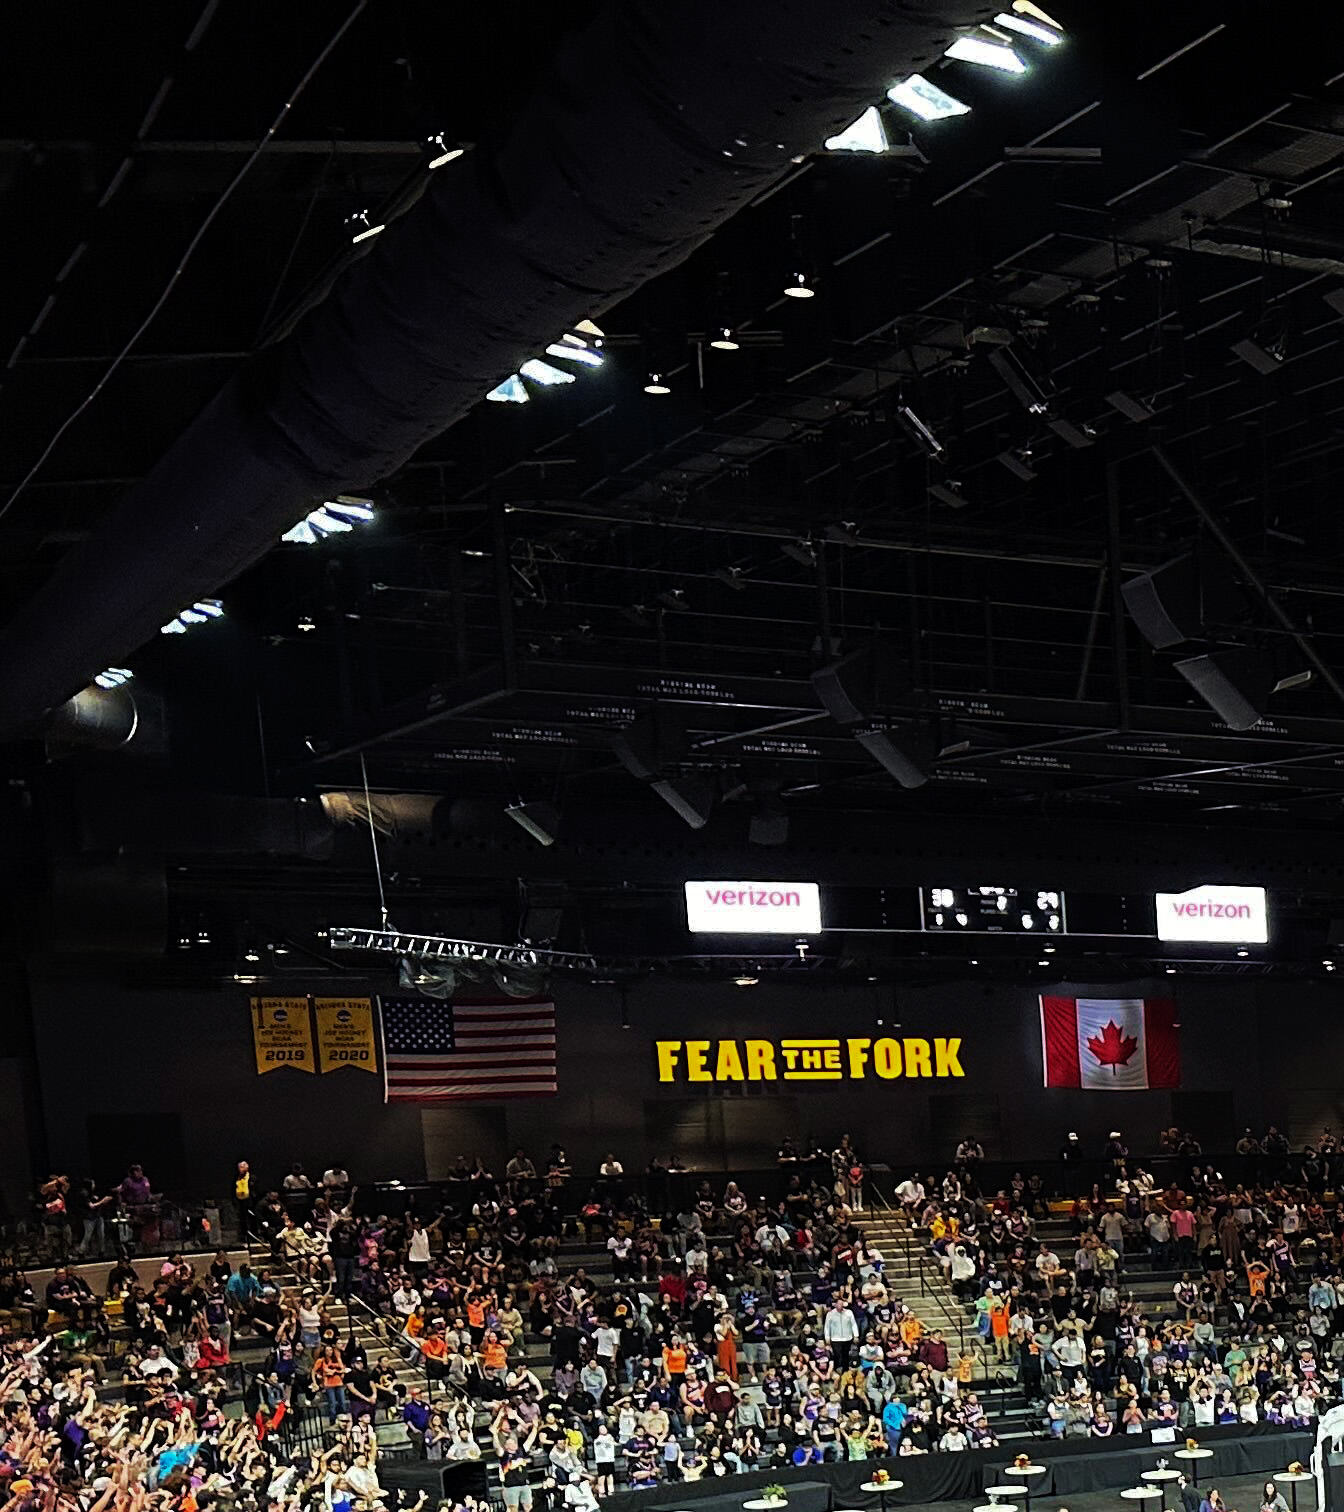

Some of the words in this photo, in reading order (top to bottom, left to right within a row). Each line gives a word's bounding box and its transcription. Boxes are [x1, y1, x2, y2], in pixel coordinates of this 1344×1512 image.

[705, 886, 801, 907] verizon
[1171, 896, 1252, 922] verizon
[265, 1050, 305, 1061] 2019
[329, 1050, 369, 1061] 2020
[655, 1040, 777, 1082] FEAR
[782, 1050, 842, 1069] THE
[846, 1037, 965, 1079] FORK
